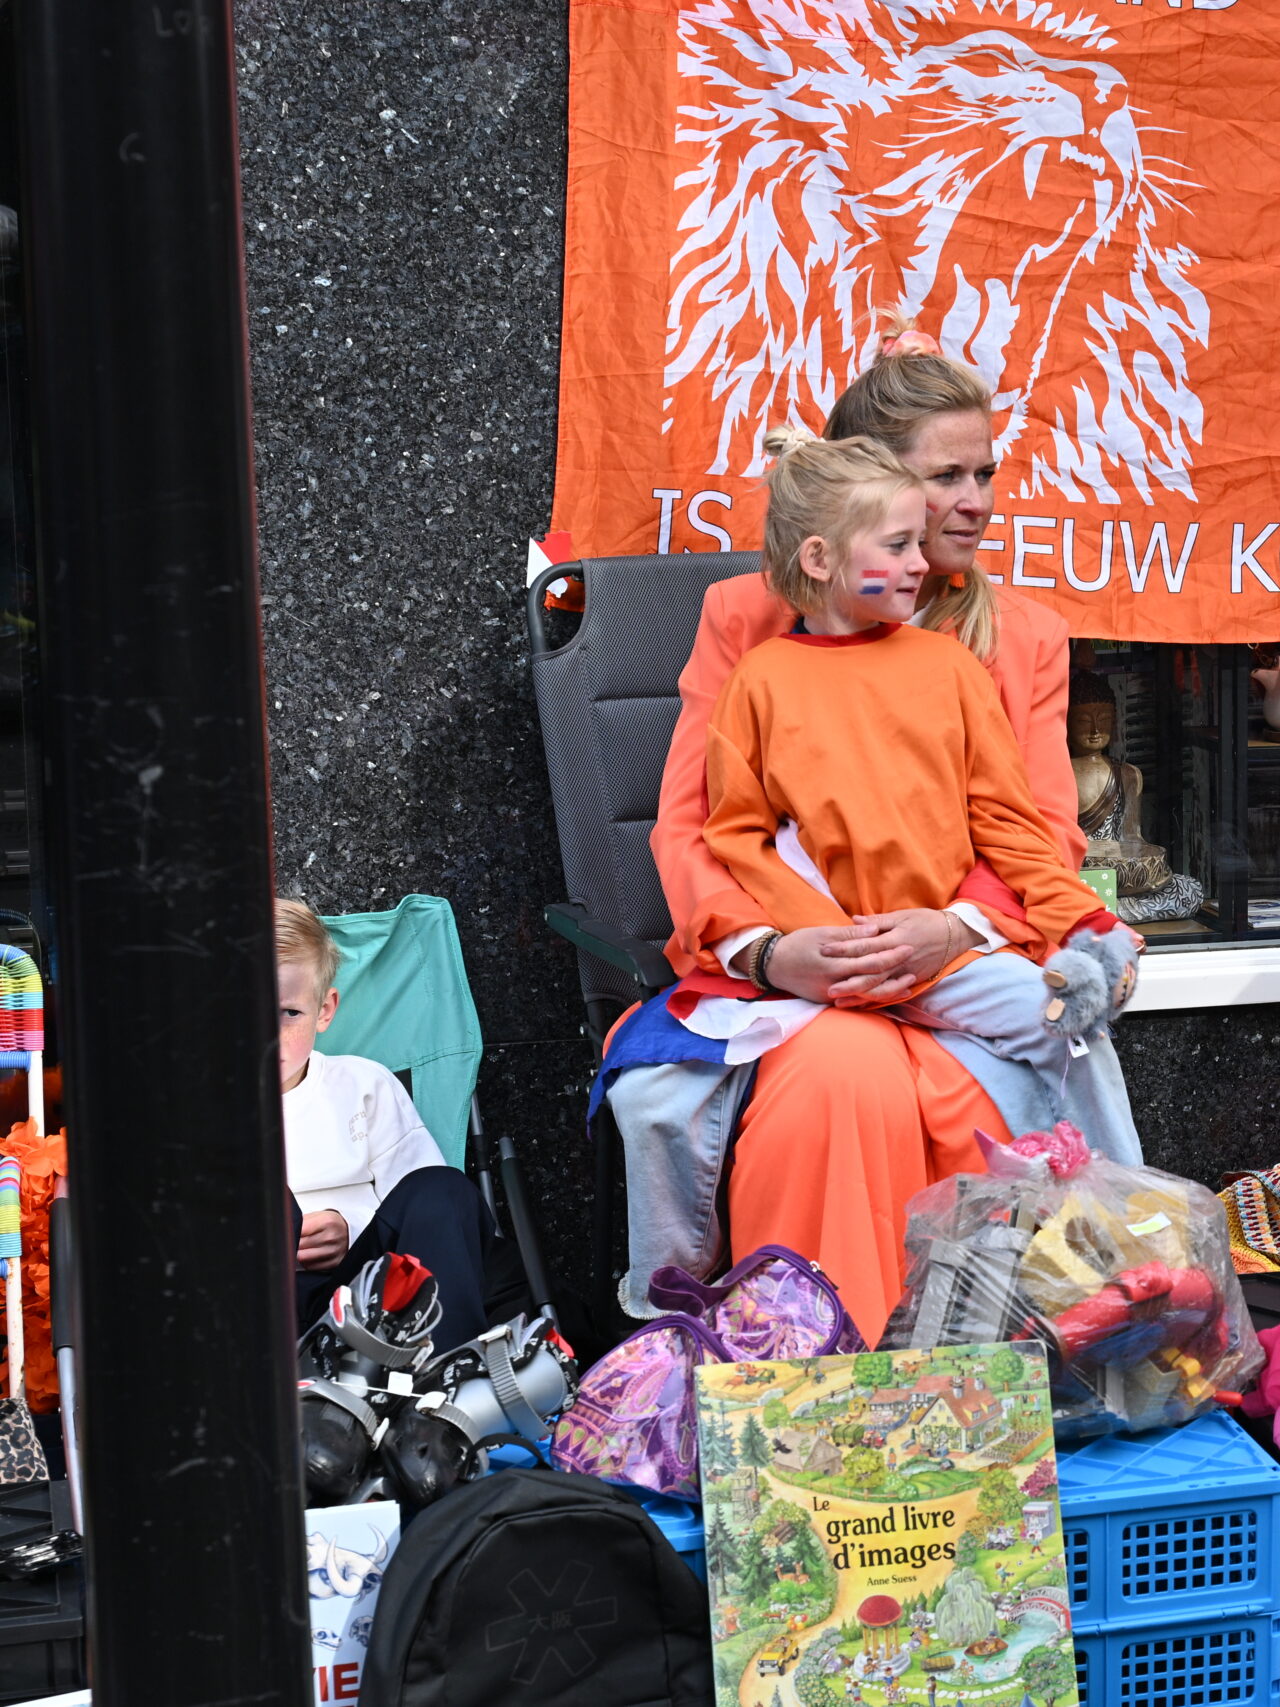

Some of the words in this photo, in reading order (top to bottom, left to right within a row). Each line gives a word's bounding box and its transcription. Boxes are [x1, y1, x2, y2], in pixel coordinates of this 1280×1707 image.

[652, 488, 733, 553] IS
[813, 1497, 830, 1511] Le
[826, 1506, 896, 1544] grand
[903, 1505, 955, 1531] livre
[833, 1542, 956, 1570] d'images
[867, 1577, 890, 1587] Anne
[892, 1574, 917, 1585] Suess
